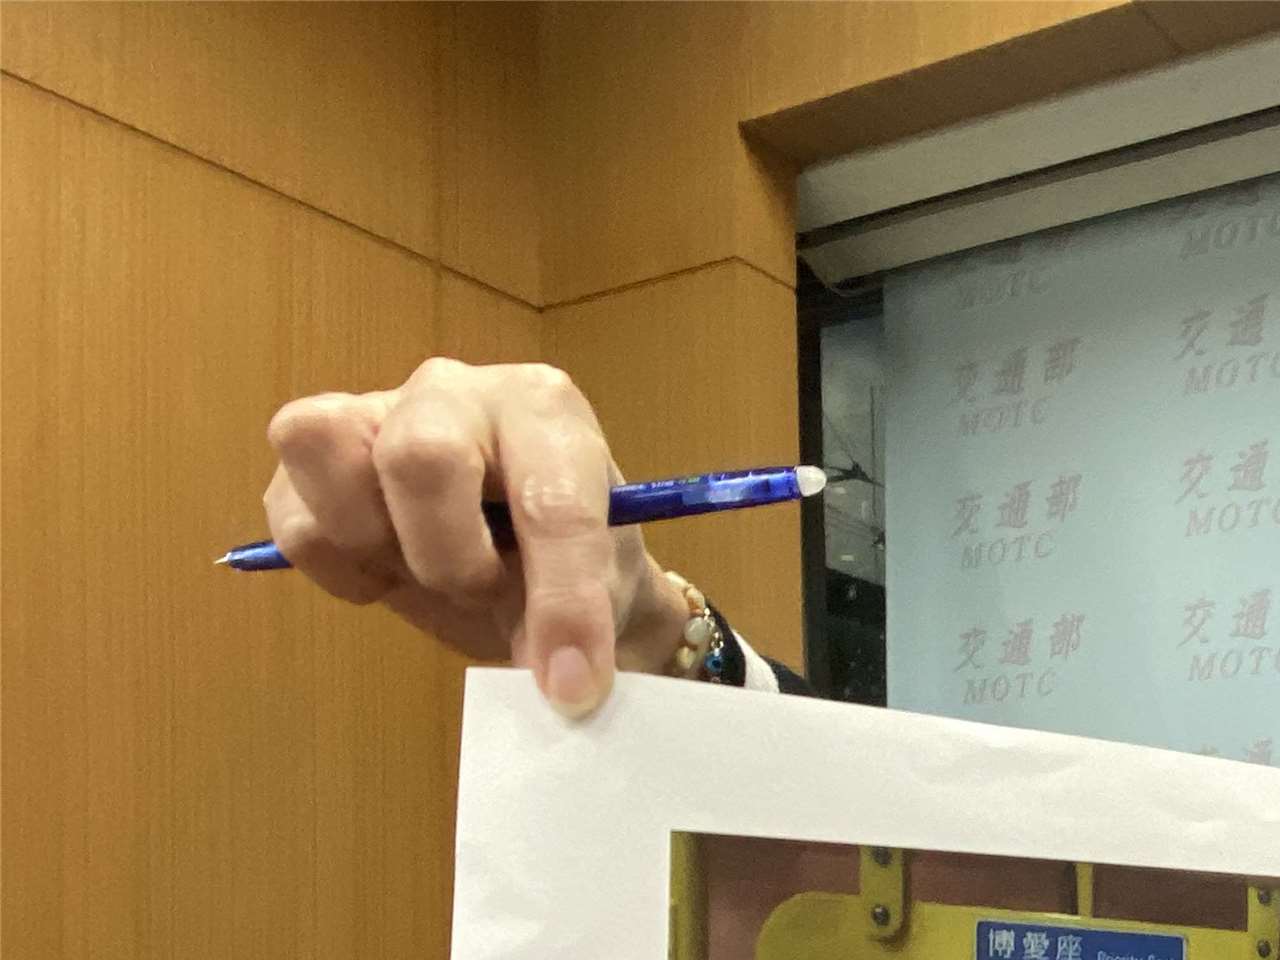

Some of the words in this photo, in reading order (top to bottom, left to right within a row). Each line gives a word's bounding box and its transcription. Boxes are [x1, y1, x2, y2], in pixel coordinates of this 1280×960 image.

[951, 473, 1083, 539] 交通部
[961, 532, 1055, 569] MOTC
[954, 612, 1086, 674] 交通部
[963, 667, 1057, 705] MOTC
